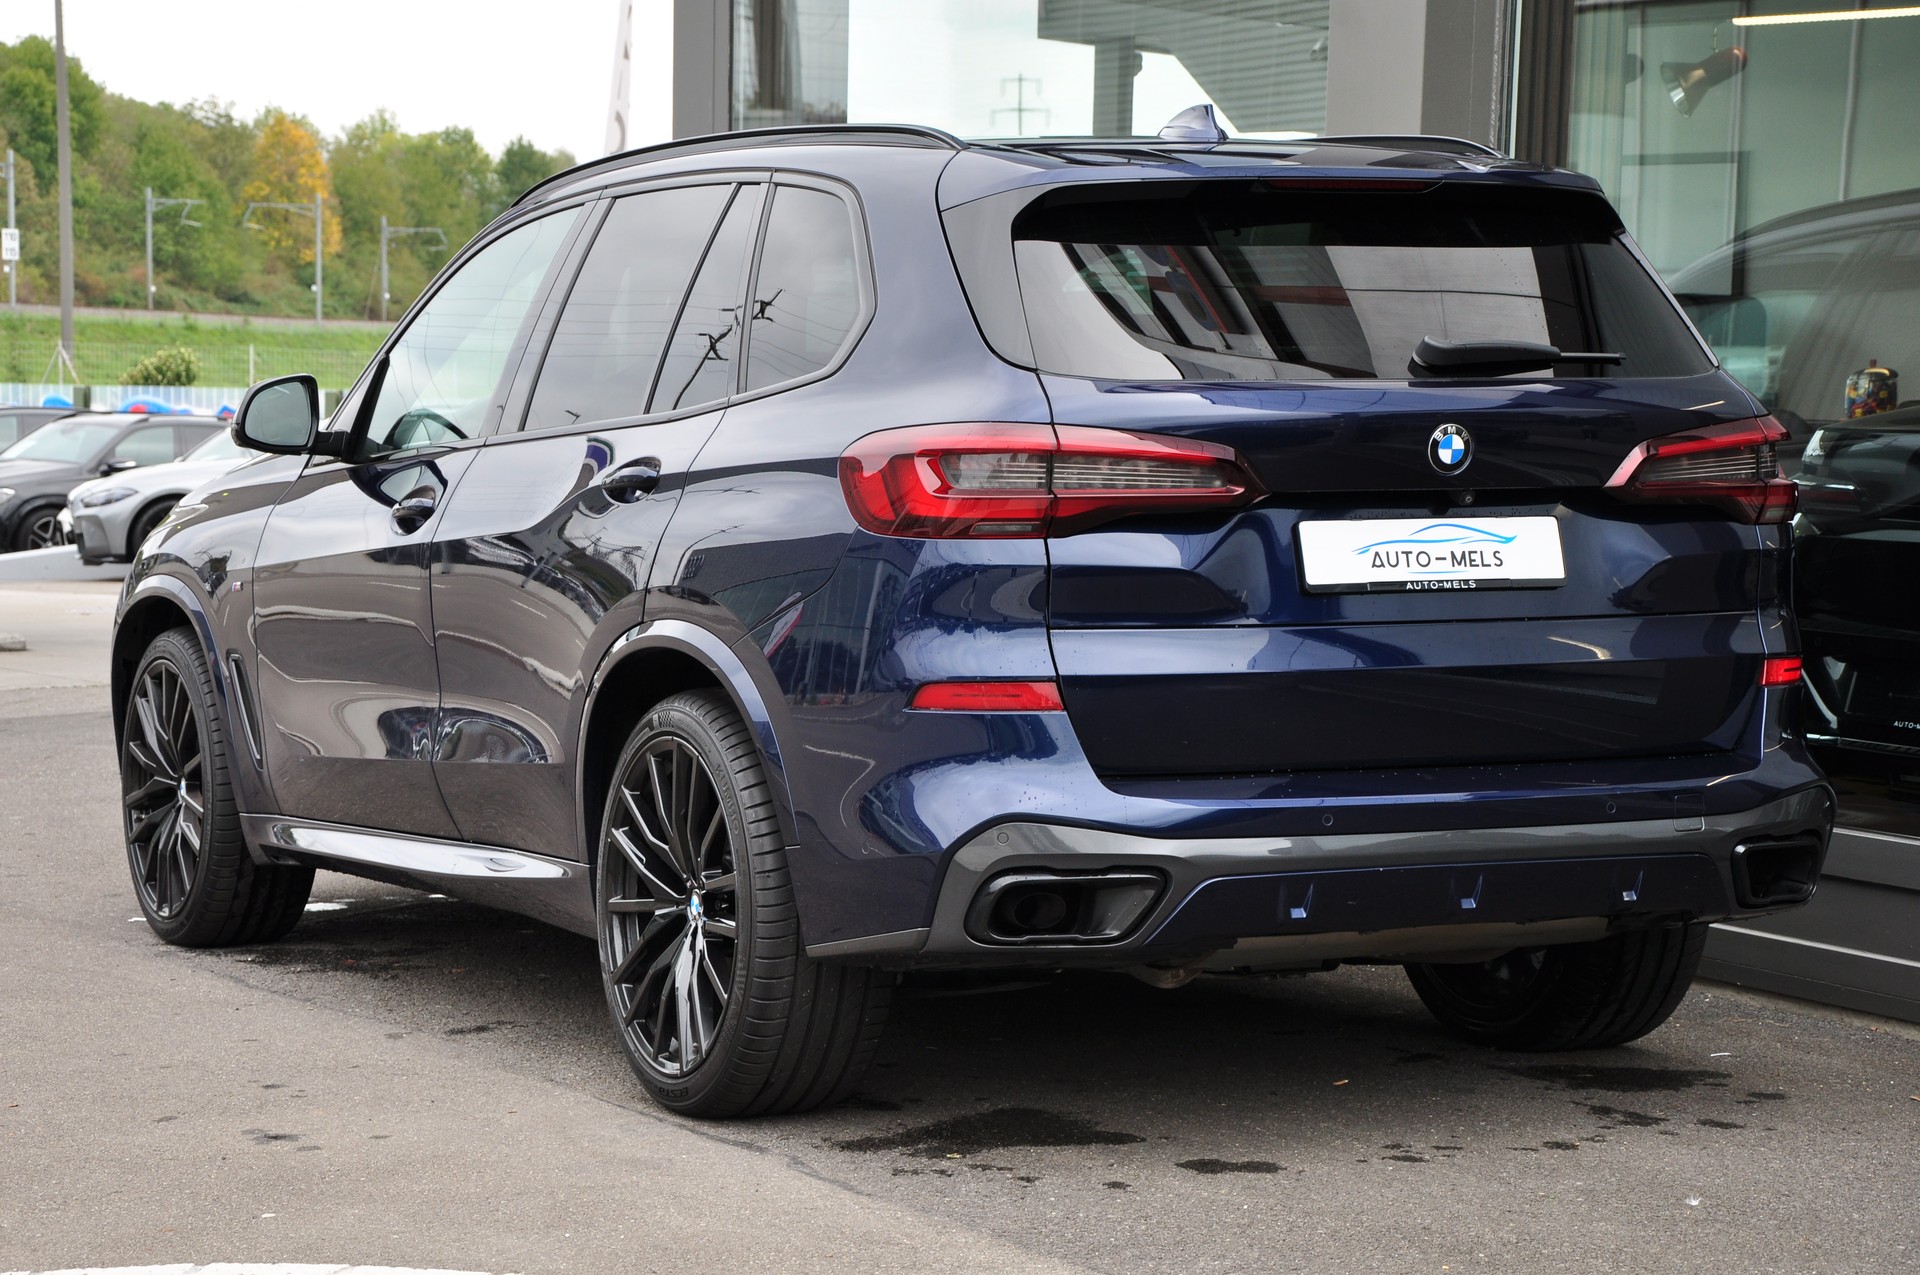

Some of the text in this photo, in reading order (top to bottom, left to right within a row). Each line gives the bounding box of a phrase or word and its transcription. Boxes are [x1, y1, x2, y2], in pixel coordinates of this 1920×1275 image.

[1434, 425, 1469, 442] BMW
[1371, 550, 1504, 568] AUTO-MELS
[1406, 580, 1477, 590] AUTO-MELS
